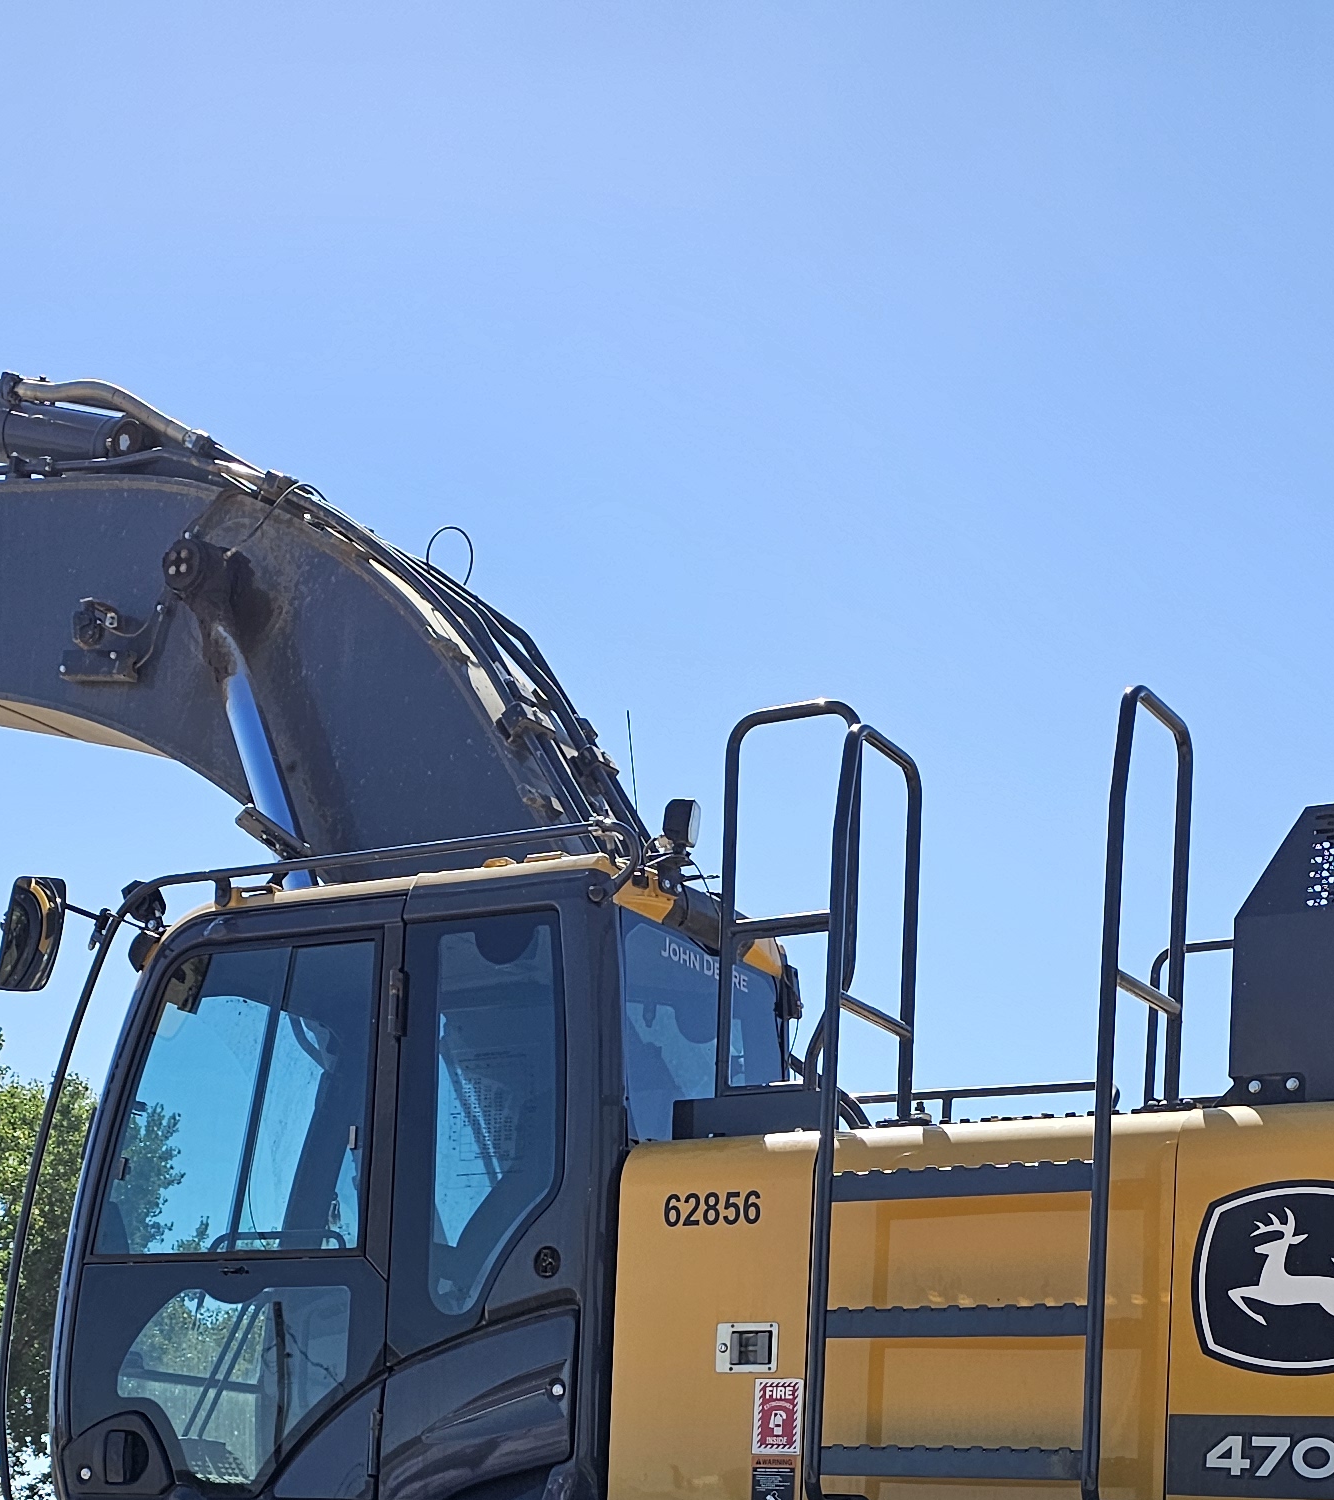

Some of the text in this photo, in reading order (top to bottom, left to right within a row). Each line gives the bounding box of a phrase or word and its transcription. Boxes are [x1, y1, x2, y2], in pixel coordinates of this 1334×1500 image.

[661, 937, 749, 993] JOHN DERE
[664, 1190, 761, 1227] 62856
[765, 1386, 794, 1399] FIRE
[766, 1436, 788, 1445] INSIDE
